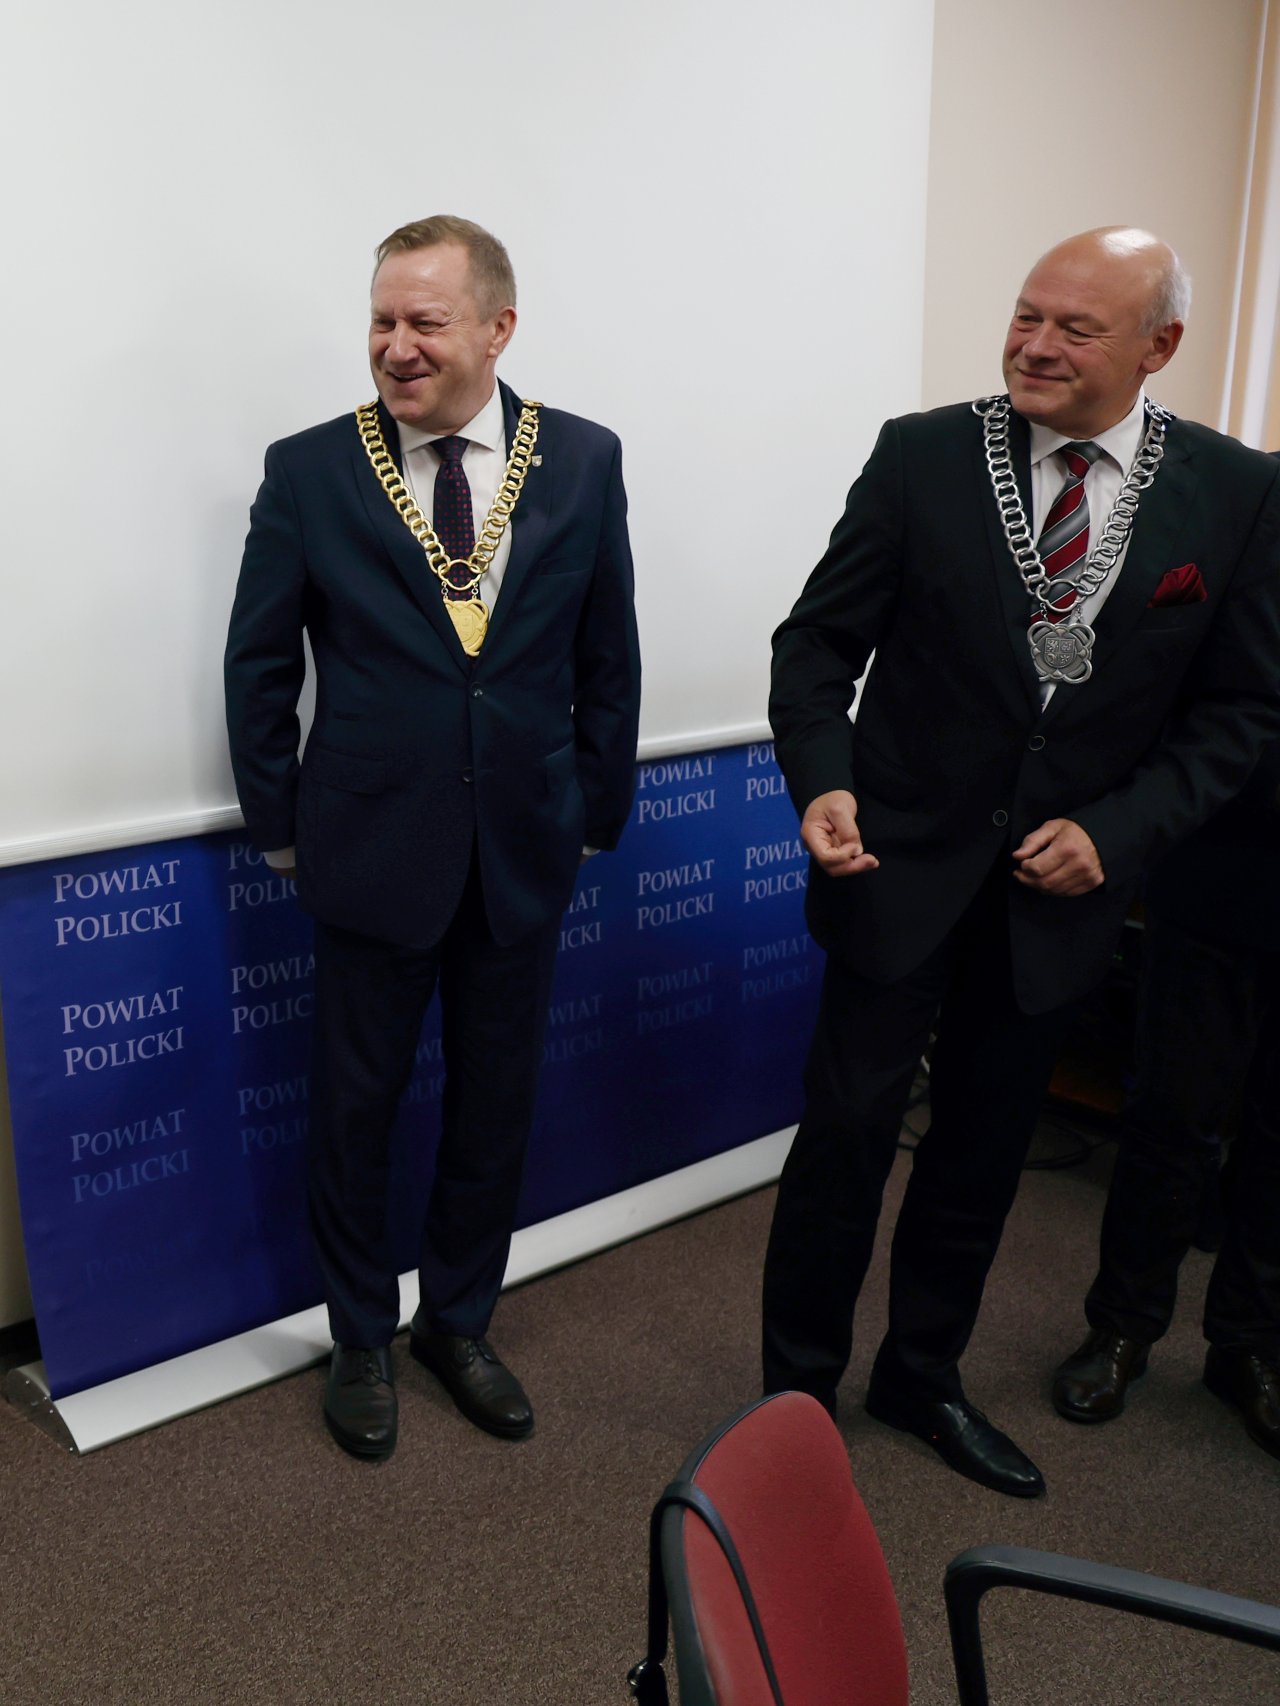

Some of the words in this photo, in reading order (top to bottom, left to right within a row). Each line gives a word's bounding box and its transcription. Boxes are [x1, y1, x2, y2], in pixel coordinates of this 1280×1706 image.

[638, 755, 715, 789] POWIAT
[746, 775, 786, 801] POLI
[638, 789, 715, 824] POLICKI
[745, 839, 809, 870] POWIA
[53, 860, 180, 903] POWIAT
[229, 878, 297, 912] POLI
[637, 859, 715, 896] POWIAT
[744, 869, 807, 904] POLICK
[55, 901, 182, 946] POLICKI
[637, 893, 714, 930] POLICKI
[558, 922, 601, 951] ICKI
[743, 934, 810, 970] POWIAT
[231, 953, 315, 994] POWIA
[638, 961, 713, 1001] POWIAT
[61, 987, 184, 1034] POWIAT
[232, 993, 314, 1034] POLIC
[548, 993, 603, 1026] WIAT
[64, 1027, 184, 1076] POLICKI
[237, 1074, 311, 1116] POWI
[70, 1108, 186, 1162] POWIAT
[240, 1117, 309, 1155] POLI
[72, 1150, 191, 1204] POLICKI
